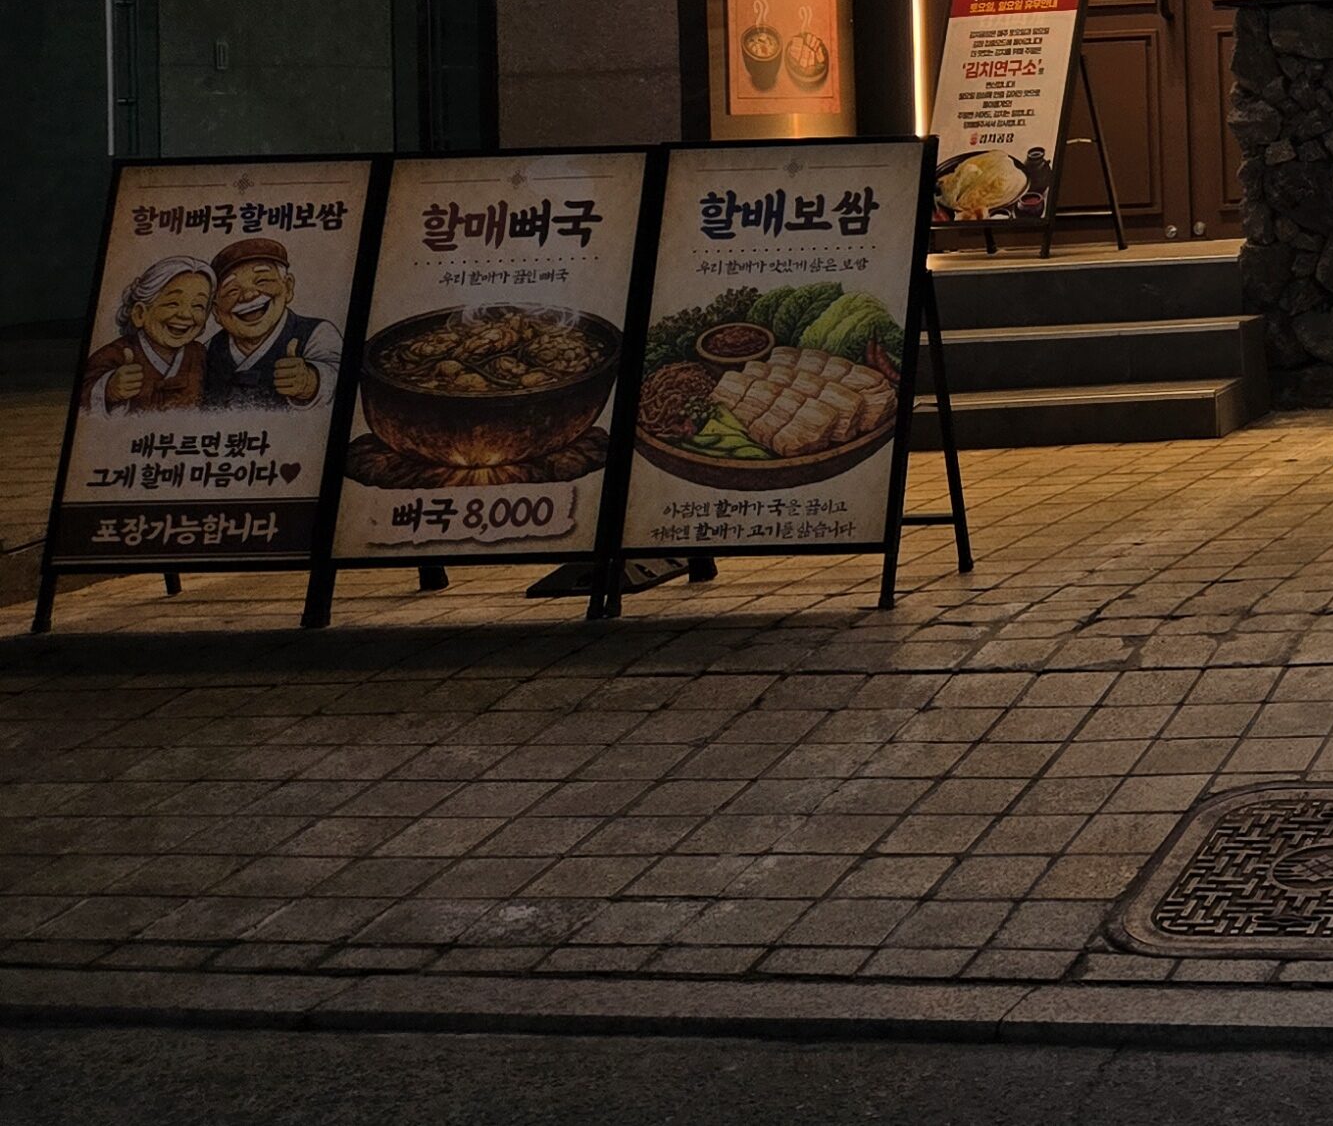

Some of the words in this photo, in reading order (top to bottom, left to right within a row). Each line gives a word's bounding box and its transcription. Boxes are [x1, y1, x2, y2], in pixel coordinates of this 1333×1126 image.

[131, 203, 237, 235] 할매뼈국
[240, 201, 347, 233] 할배보쌈
[422, 198, 603, 252] 할매뼈국
[700, 186, 880, 240] 할배보쌈
[439, 270, 466, 286] 우리
[469, 270, 510, 286] 할매가
[539, 268, 569, 283] 뼈국
[695, 260, 722, 275] 우리
[725, 259, 766, 274] 할배가
[769, 259, 807, 273] 맛있게
[131, 432, 220, 458] 배부르면
[225, 431, 270, 457] 됐다
[87, 463, 136, 488] 그게
[141, 462, 185, 489] 할매
[190, 461, 278, 488] 마음이다
[392, 498, 458, 533] 뼈국
[463, 497, 554, 535] 8,000
[663, 502, 710, 518] 아침엔
[714, 499, 764, 518] 할매가
[767, 499, 801, 515] 국을
[91, 511, 279, 546] 포장가능합니다
[693, 523, 744, 540] 할배가
[747, 522, 795, 538] 고기를
[797, 522, 857, 538] 삶습니다
